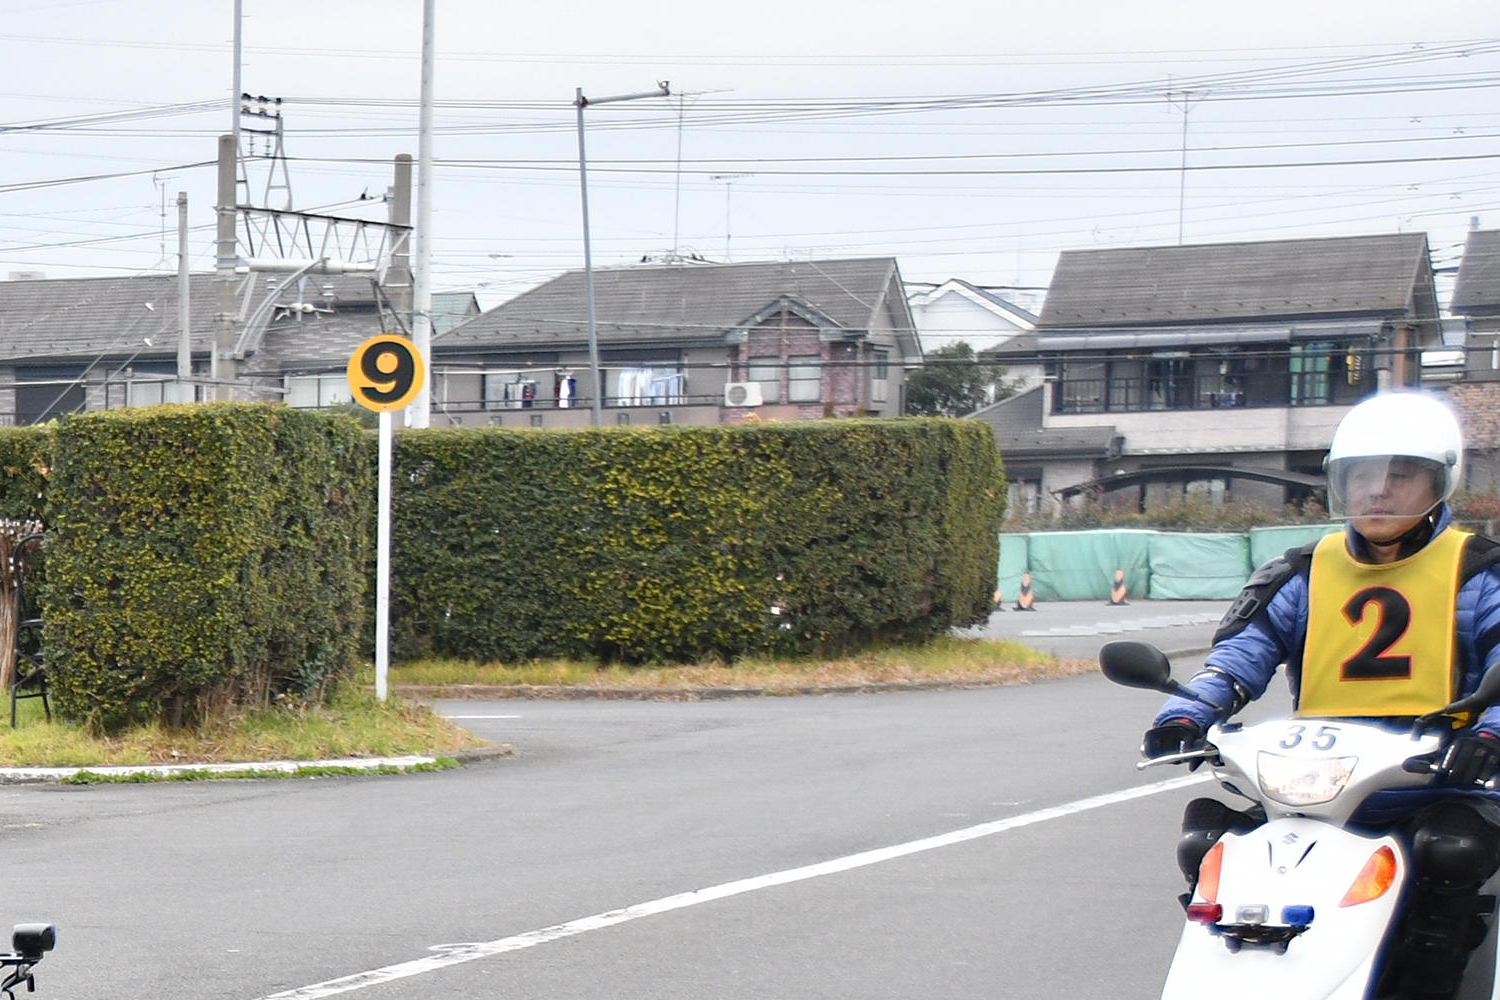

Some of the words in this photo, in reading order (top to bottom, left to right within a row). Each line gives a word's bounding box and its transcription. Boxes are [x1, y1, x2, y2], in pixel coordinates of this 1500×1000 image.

[359, 341, 415, 404] 9
[1340, 585, 1412, 681] 2
[1279, 725, 1341, 751] 35
